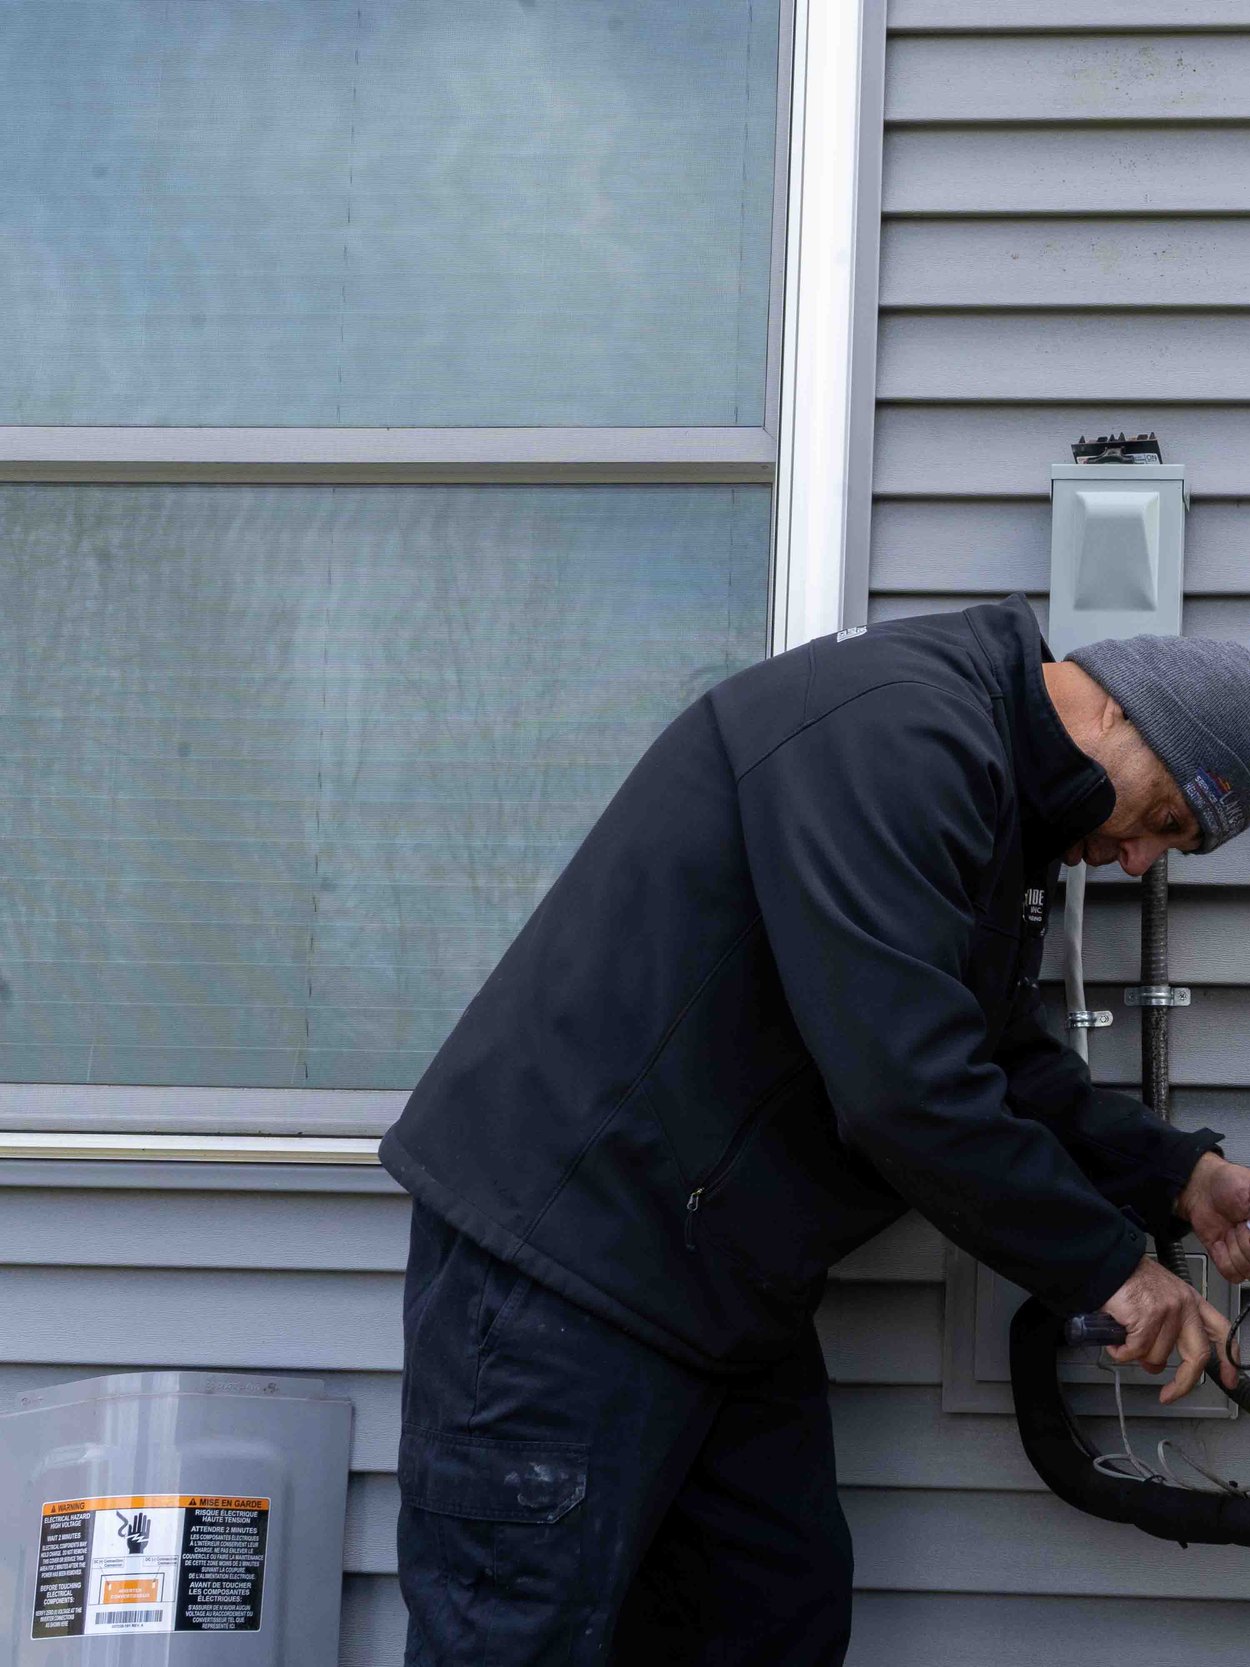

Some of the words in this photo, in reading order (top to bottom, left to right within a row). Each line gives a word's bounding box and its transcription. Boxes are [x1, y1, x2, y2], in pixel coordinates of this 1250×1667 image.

[58, 1502, 85, 1512] WARNING
[199, 1499, 219, 1507] MISE
[222, 1499, 232, 1507] EN
[235, 1500, 262, 1509] GARDE
[44, 1515, 70, 1524] ELECTRICAL
[62, 1520, 81, 1528] VOLTAGE
[40, 1584, 57, 1592] BEFORE
[203, 1588, 250, 1596] COMPOSANTES
[47, 1590, 72, 1598] ELECTRICAL
